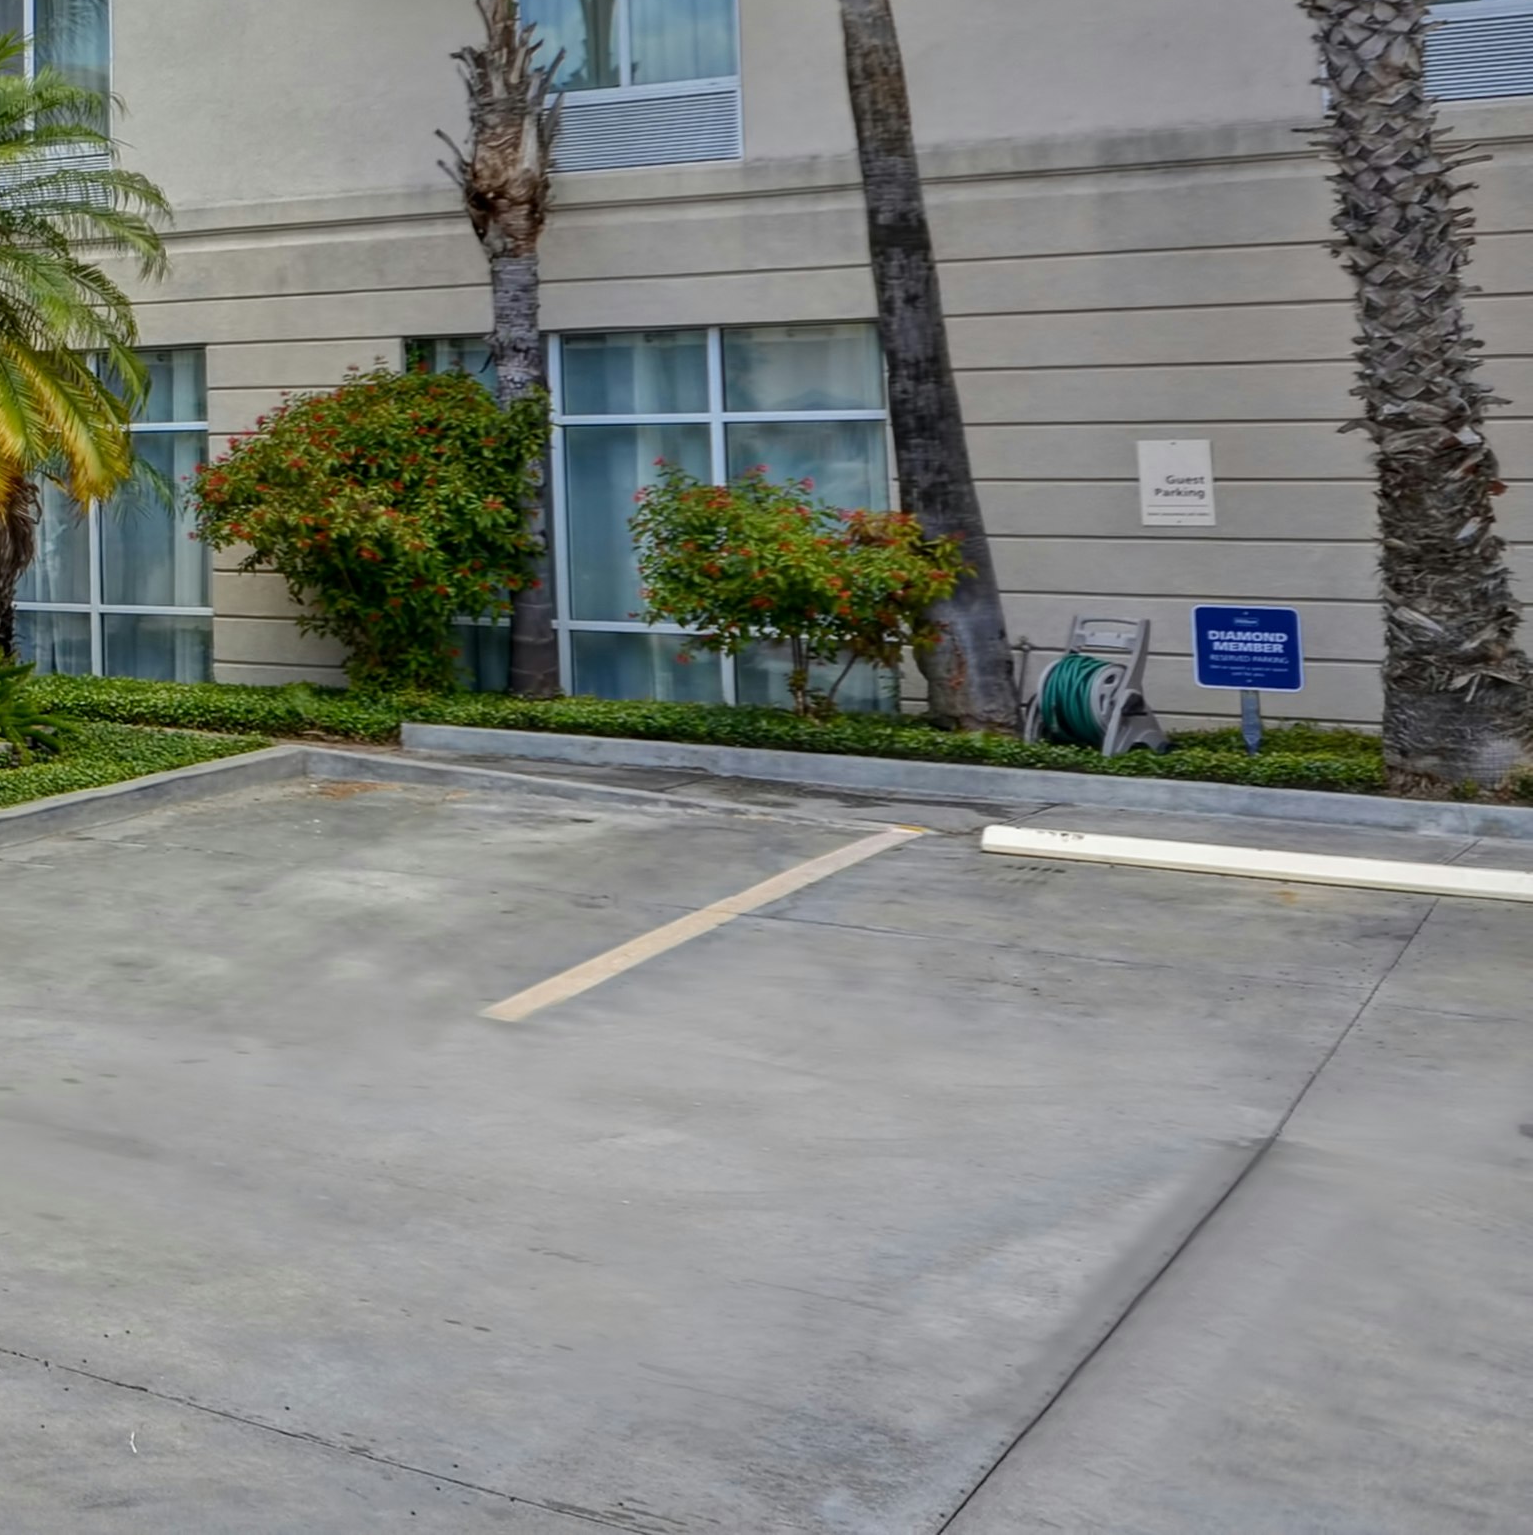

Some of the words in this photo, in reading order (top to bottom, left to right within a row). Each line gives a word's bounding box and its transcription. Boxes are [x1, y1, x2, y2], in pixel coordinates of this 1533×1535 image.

[1165, 474, 1206, 485] Guest
[1154, 487, 1206, 500] Parking
[1207, 630, 1289, 643] DIAMOND
[1212, 641, 1285, 654] MEMBER
